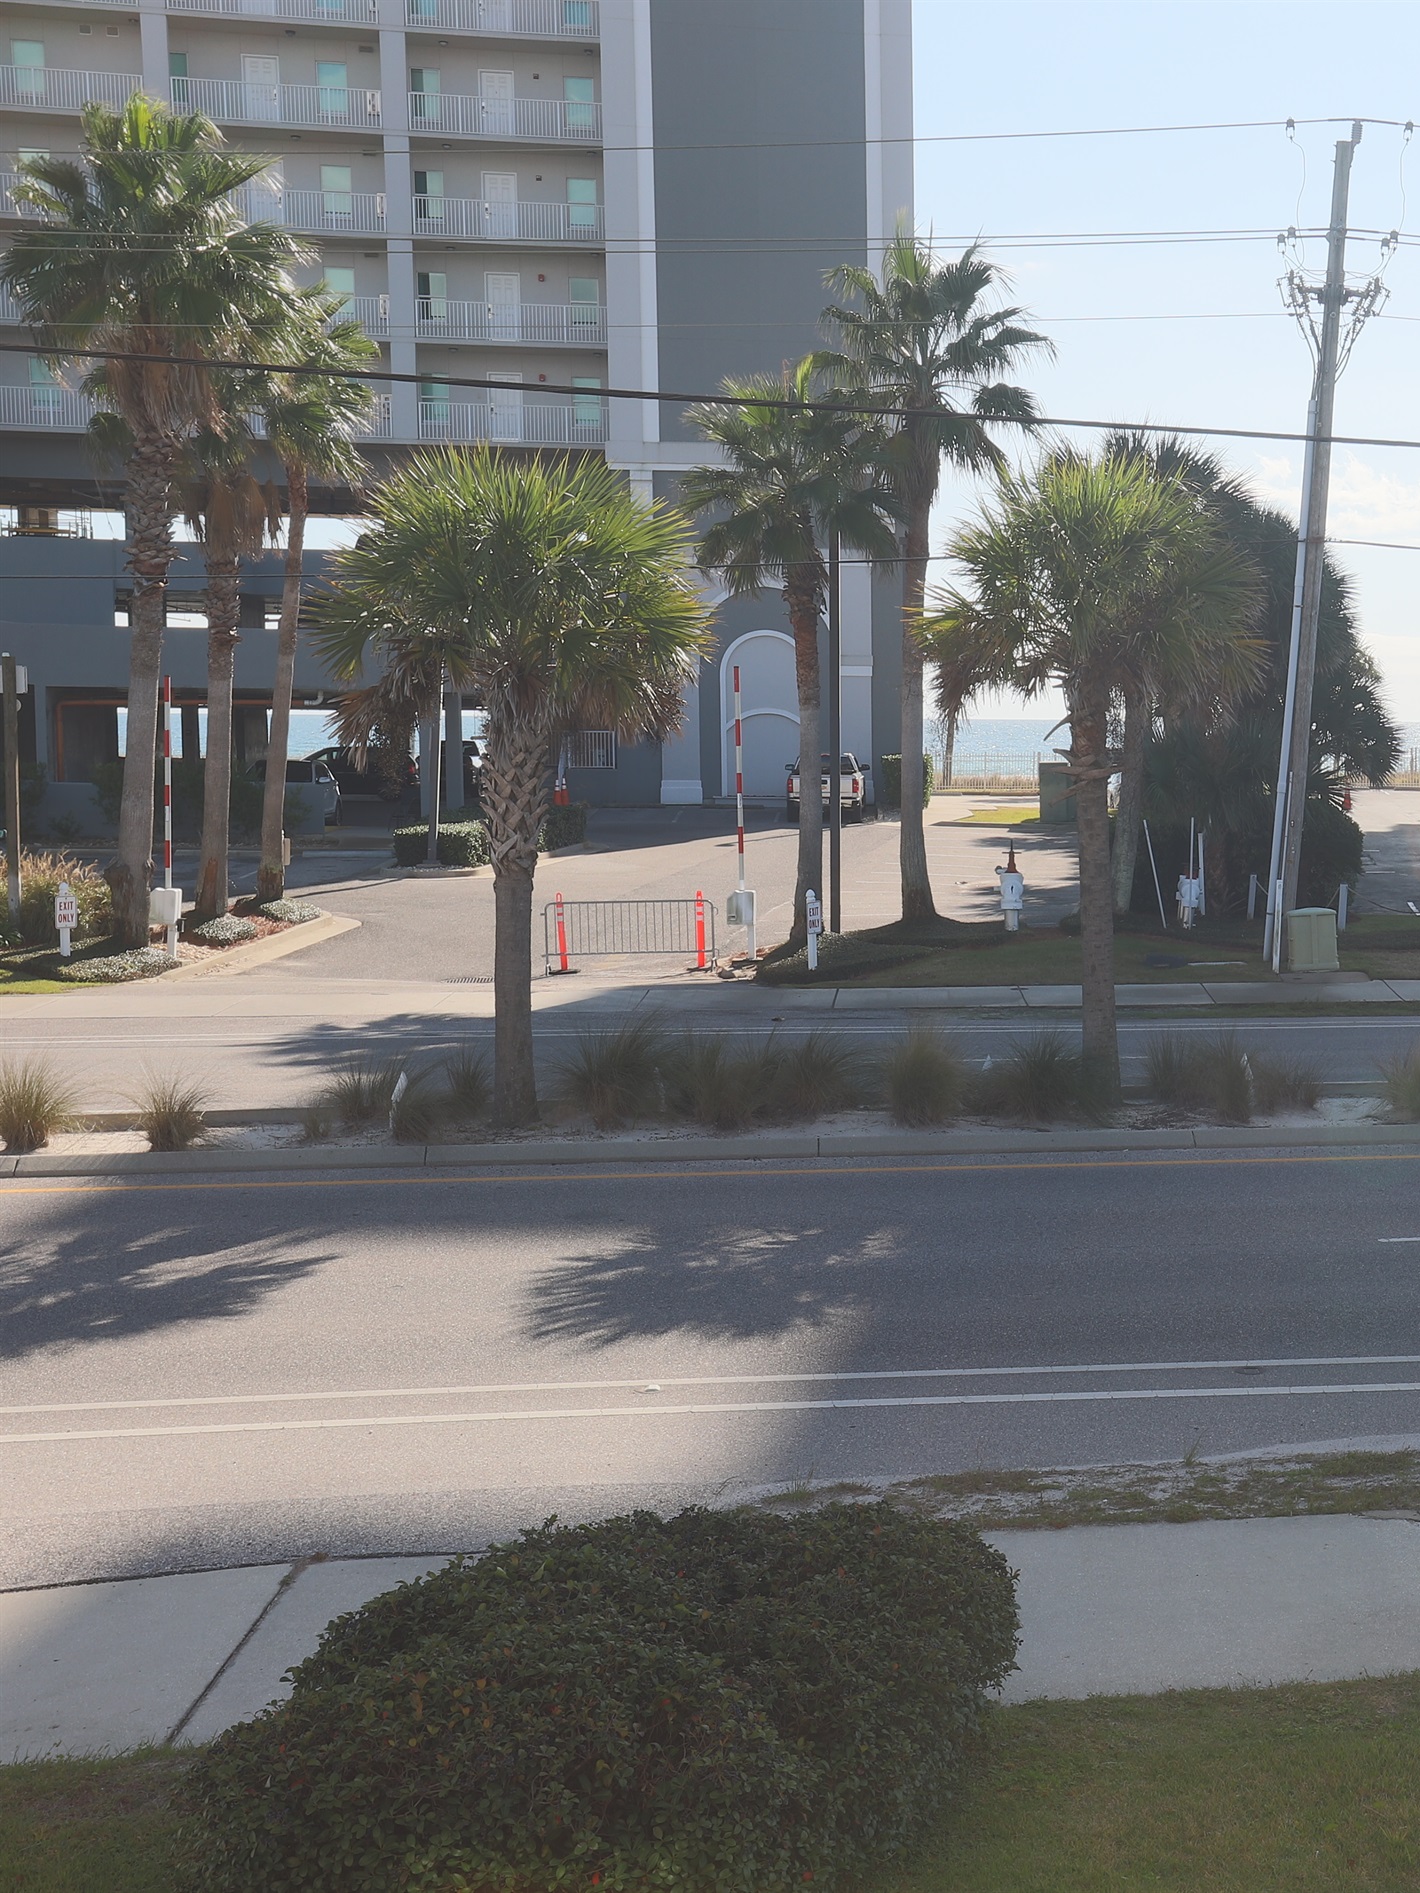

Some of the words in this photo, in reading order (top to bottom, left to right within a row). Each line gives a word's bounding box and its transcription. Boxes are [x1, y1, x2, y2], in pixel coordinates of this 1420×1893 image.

[58, 901, 74, 911] EXIT
[809, 907, 819, 917] EXIT
[57, 914, 75, 923] ONLY
[809, 919, 820, 928] ONLY
